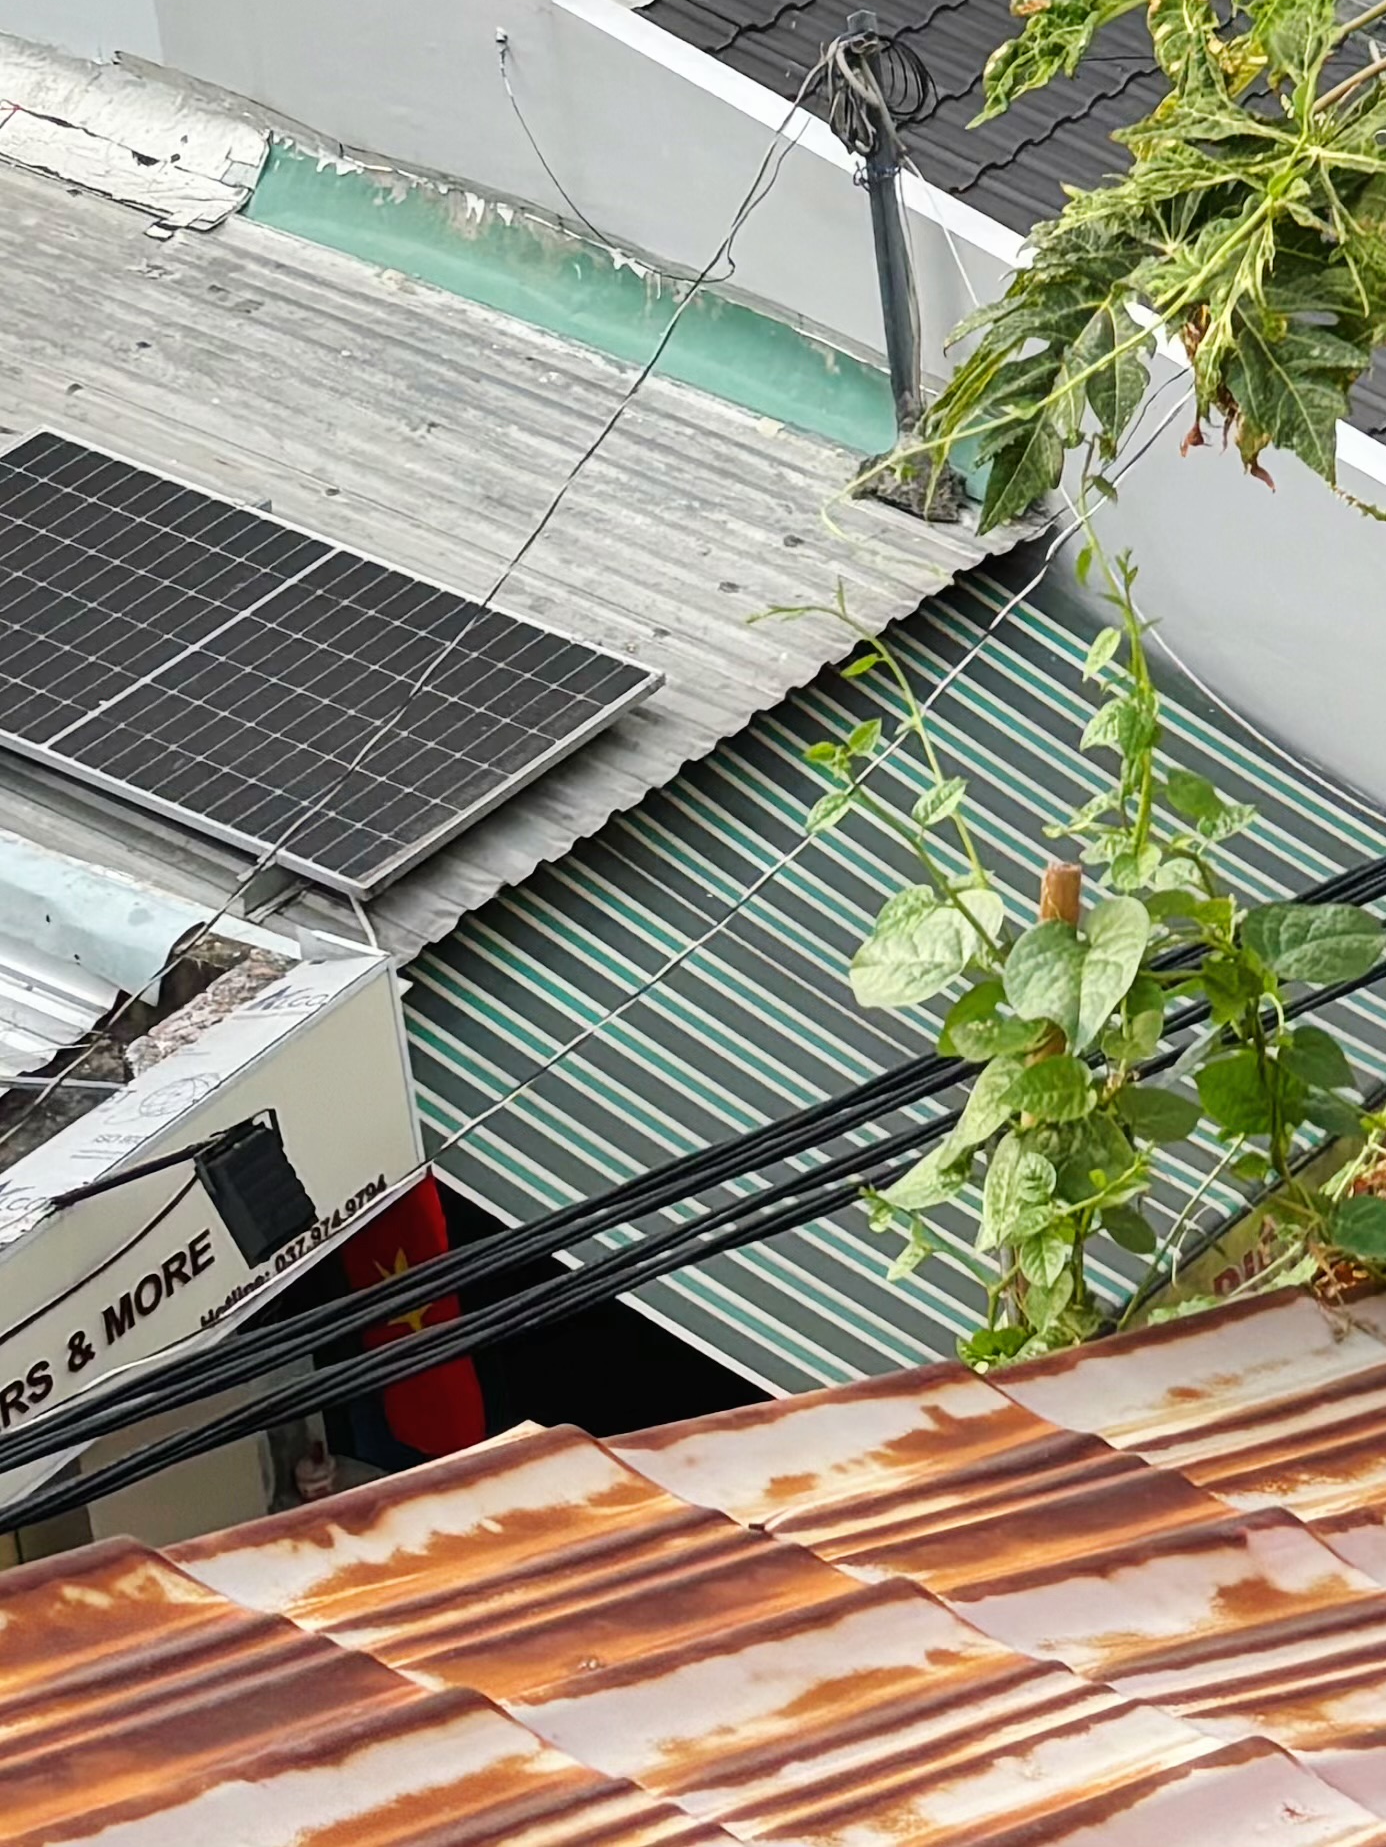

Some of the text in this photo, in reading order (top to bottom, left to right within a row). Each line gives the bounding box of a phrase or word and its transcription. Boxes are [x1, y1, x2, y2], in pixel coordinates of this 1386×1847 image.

[273, 1173, 388, 1273] 037.974.9794
[67, 1330, 96, 1373] &
[101, 1228, 215, 1345] MORE
